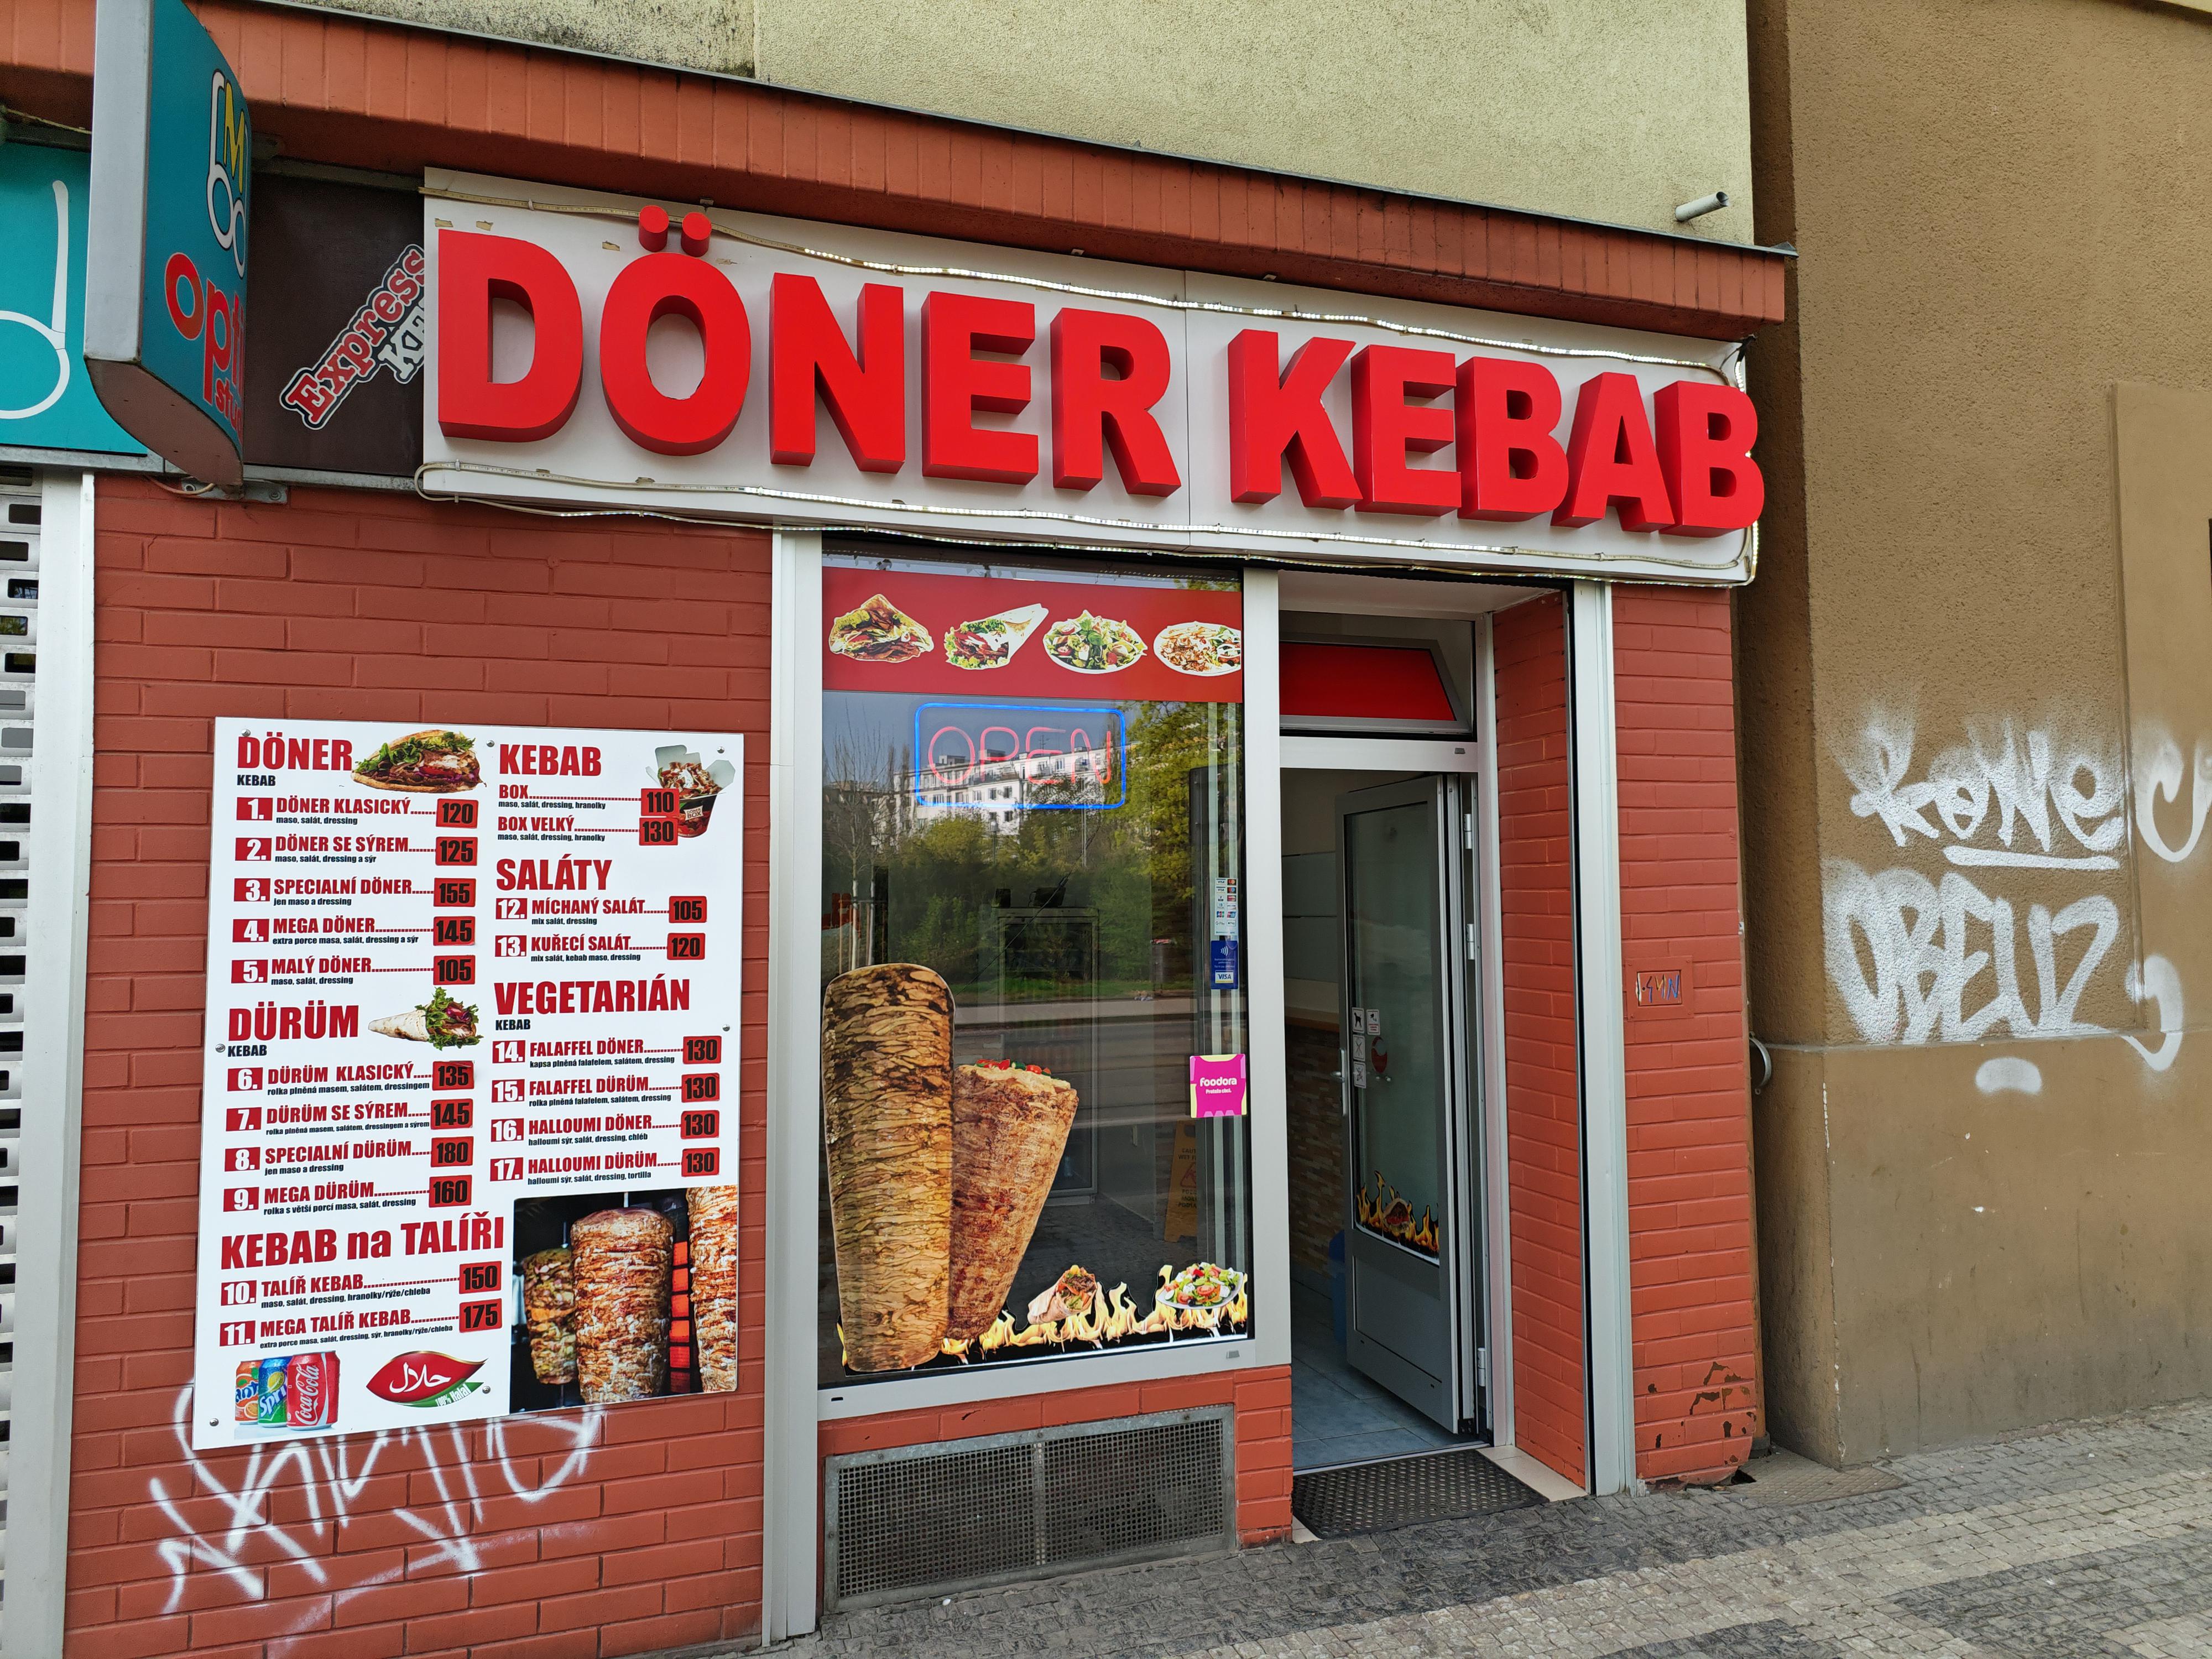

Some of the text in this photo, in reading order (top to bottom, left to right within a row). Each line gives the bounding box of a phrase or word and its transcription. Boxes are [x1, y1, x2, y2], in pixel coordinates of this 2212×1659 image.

[439, 205, 1765, 538] DÖNER KEBAB
[237, 731, 352, 771] DÖNER
[499, 744, 601, 776] KEBAB
[928, 726, 1112, 784] OPEN
[237, 774, 276, 786] KEBAB
[248, 795, 473, 824] 1. DÖNER KLASICKÝ 120
[499, 784, 674, 813] BOX 110
[541, 801, 574, 809] dressing,
[575, 801, 606, 810] hranolky
[301, 816, 322, 825] salát,
[324, 817, 358, 825] dressing
[498, 815, 674, 842] BOX VELKÝ 130
[247, 833, 473, 863] 2. DÖNER SE SÝREM 125
[496, 853, 612, 891] SALÁTY
[246, 877, 470, 904] 3. SPECIALNÍ DÖNER 155
[273, 898, 286, 906] jen
[317, 898, 352, 906] dressing
[498, 897, 702, 920] 12. MÍCHANÝ SALÁT 105
[546, 917, 565, 925] salát,
[243, 915, 472, 942] 4. MEGA DÖNER 145
[343, 936, 364, 944] salát,
[366, 936, 399, 944] dressing
[407, 935, 419, 943] sýr
[498, 933, 700, 957] 13. KUŘECÍ SALÁT 120
[243, 955, 471, 983] 5. MALÝ DÖNER 105
[494, 973, 690, 1015] VEGETARIÁN
[228, 1000, 359, 1041] DÜRÜM
[495, 1019, 531, 1031] KEBAB
[227, 1045, 267, 1057] KEBAB
[495, 1037, 717, 1062] 14. FALAFFEL DÖNER 130
[552, 1059, 577, 1068] plněná
[644, 1056, 675, 1064] dressing
[238, 1061, 469, 1090] 6. DÜRÜM KLASICKÝ 135
[268, 1087, 288, 1095] rolka
[289, 1086, 317, 1095] plněná
[350, 1083, 383, 1092] salátem,
[384, 1082, 430, 1091] dressingem
[494, 1074, 716, 1102] 15. FALAFFEL DÜRÜM 130
[1199, 1077, 1237, 1087] foodora
[238, 1100, 469, 1130] 7. DÜRÜM SE SÝREM 145
[493, 1113, 715, 1141] 16. HALLOUMI DÖNER 130
[528, 1137, 560, 1146] halloumi
[574, 1135, 594, 1144] salát,
[628, 1133, 648, 1141] chléb
[235, 1139, 468, 1171] 8. SPECIALNÍ DÜRÜM 180
[494, 1151, 714, 1180] 17. HALLOUMI DÜRÜM 130
[234, 1180, 468, 1211] 9. MEGA DÜRÜM 160
[221, 1211, 504, 1270] KEBAB na TALÍŘI
[224, 1265, 498, 1305] 10. TALÍŘ KEBAB 150
[286, 1297, 308, 1306] salát,
[310, 1295, 346, 1305] dressing,
[347, 1287, 430, 1301] hranolky/rýže/chleba
[224, 1303, 498, 1345] 11. MEGA TALÍŘ KEBAB 175
[389, 1361, 452, 1394] حلال
[435, 1383, 472, 1407] 100% Halal
